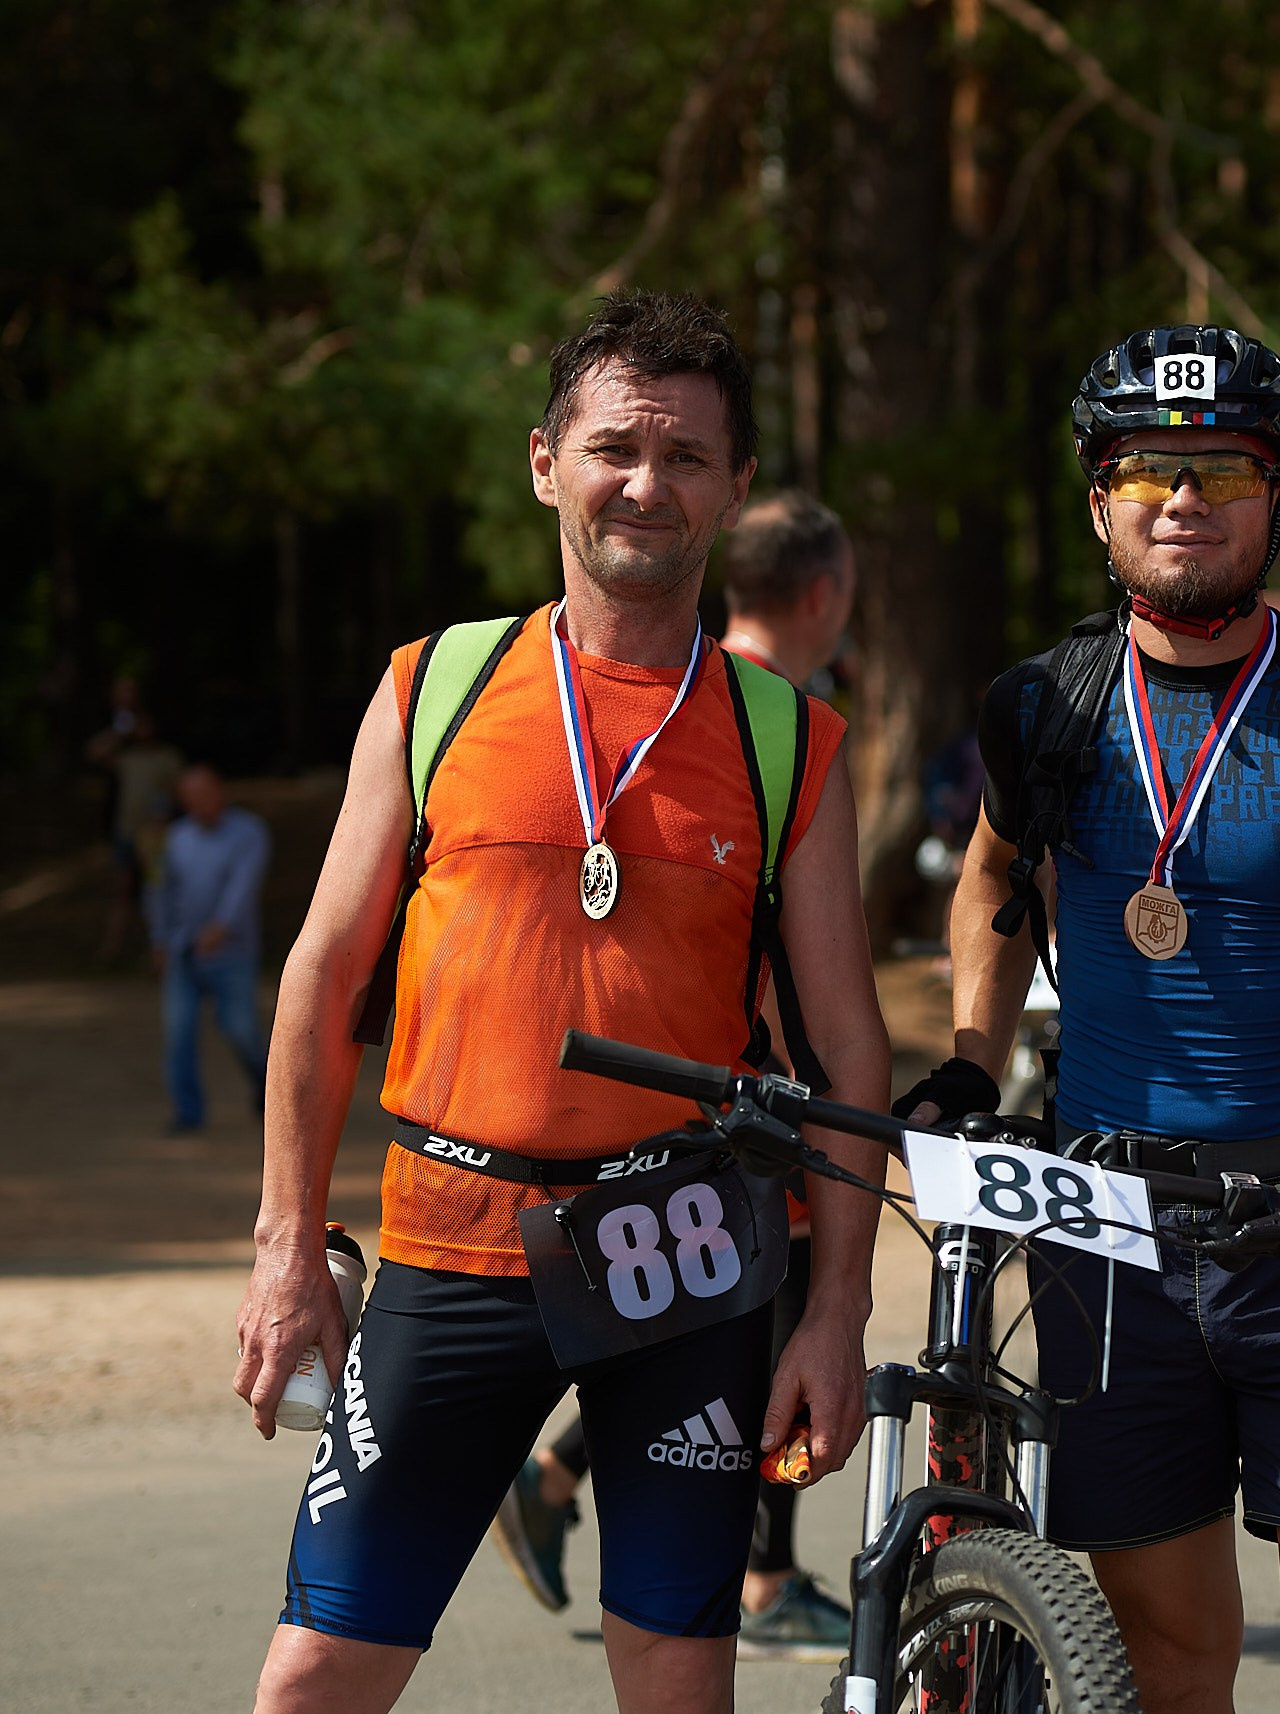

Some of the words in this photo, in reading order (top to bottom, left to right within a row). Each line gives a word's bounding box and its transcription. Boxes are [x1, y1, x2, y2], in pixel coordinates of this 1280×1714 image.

[1163, 359, 1205, 391] 88
[1141, 898, 1176, 915] МОЖГА
[422, 1135, 491, 1168] 2XU
[596, 1149, 670, 1182] 2XU
[975, 1153, 1101, 1240] 88
[596, 1182, 742, 1321] 88
[342, 1331, 383, 1473] SCANIA
[306, 1394, 349, 1526] OIL
[646, 1441, 753, 1473] adidas
